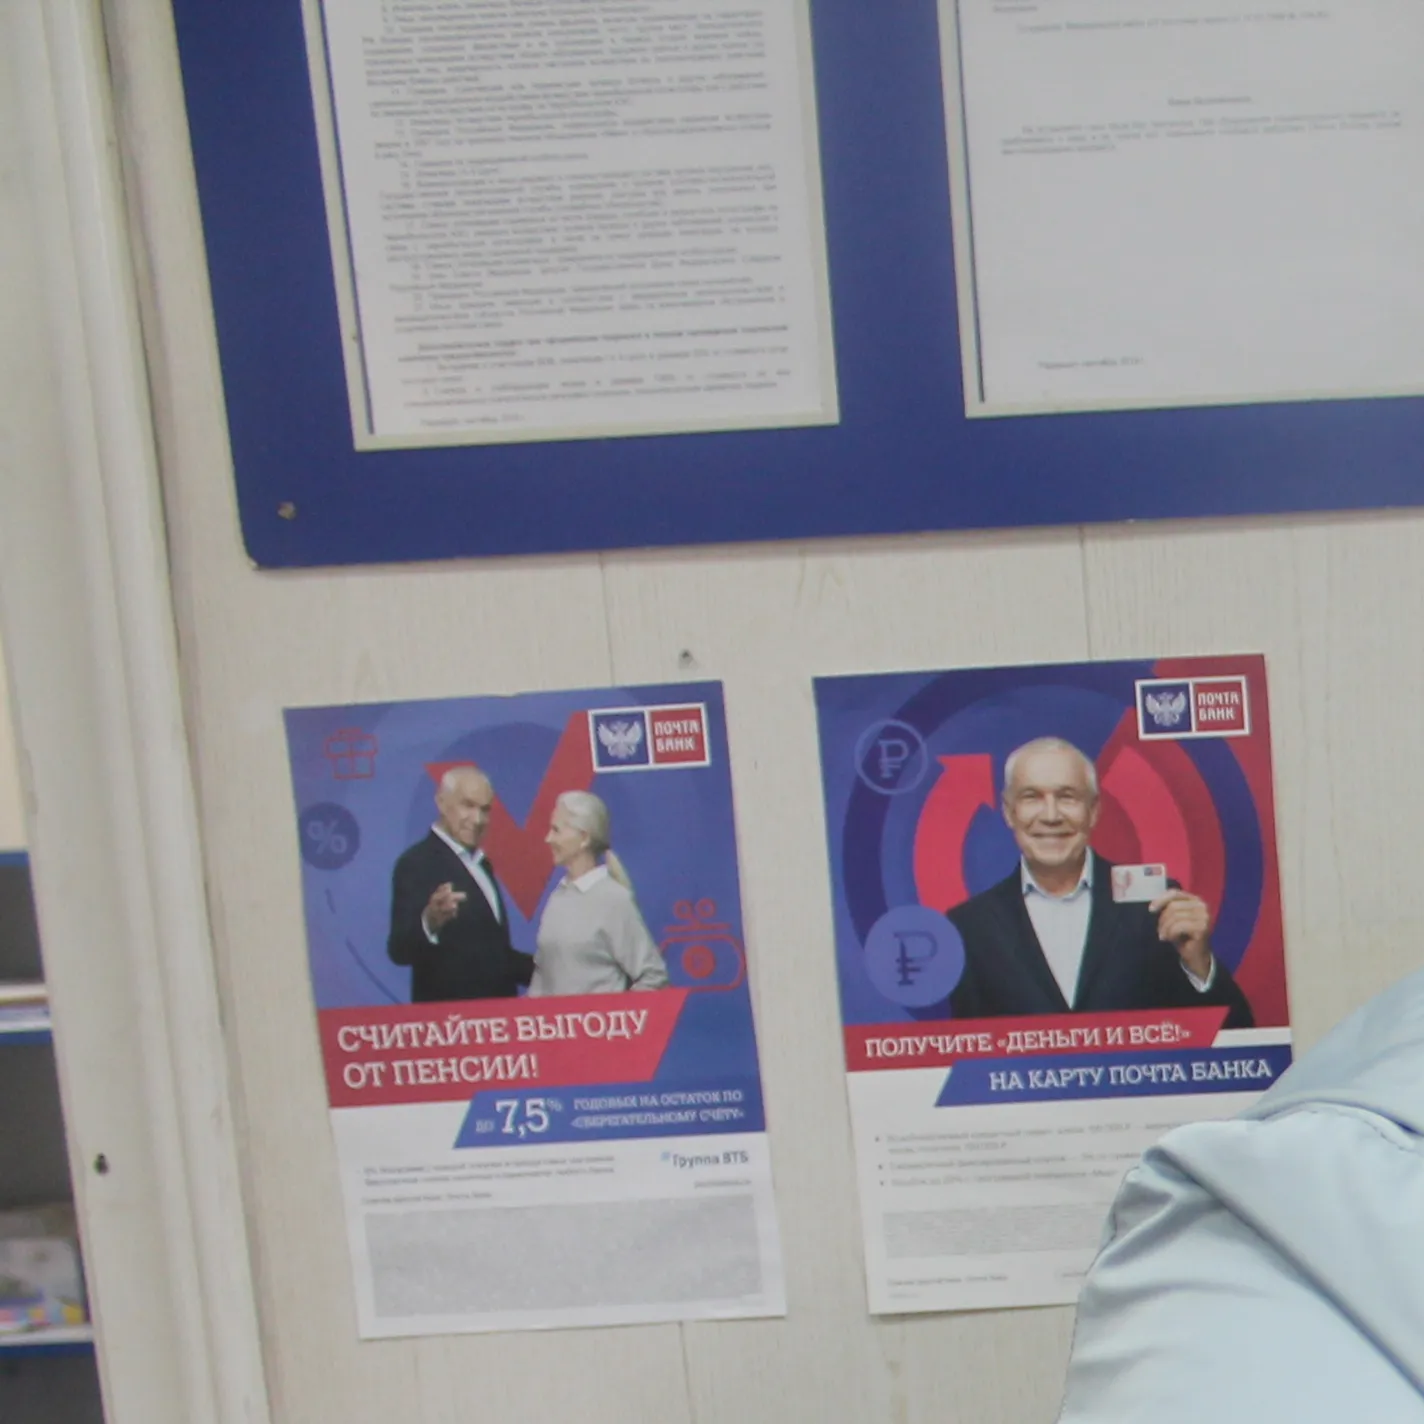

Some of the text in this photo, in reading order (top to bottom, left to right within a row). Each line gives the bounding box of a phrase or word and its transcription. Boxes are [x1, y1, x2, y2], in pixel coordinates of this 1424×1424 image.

[1197, 691, 1241, 706] ПОЧТА
[1198, 706, 1237, 722] БАНК
[653, 719, 700, 736] ПОЧТА
[655, 736, 697, 753] БАНК
[336, 1008, 650, 1053] СЧИТАЙТЕ ВЫГОДУ
[864, 1031, 993, 1059] ПОЛУЧИТЕ
[996, 1027, 1101, 1055] «ДЕНЬГИ
[1104, 1027, 1125, 1047] И
[342, 1053, 540, 1090] ОТ ПЕНСИИ!
[988, 1059, 1273, 1092] НА КАРТУ ПОЧТА БАНКА
[572, 1089, 744, 1112] ГОДОВЫХ НА ОСТАТОК ПО
[672, 1149, 750, 1169] Группа ВТБ
